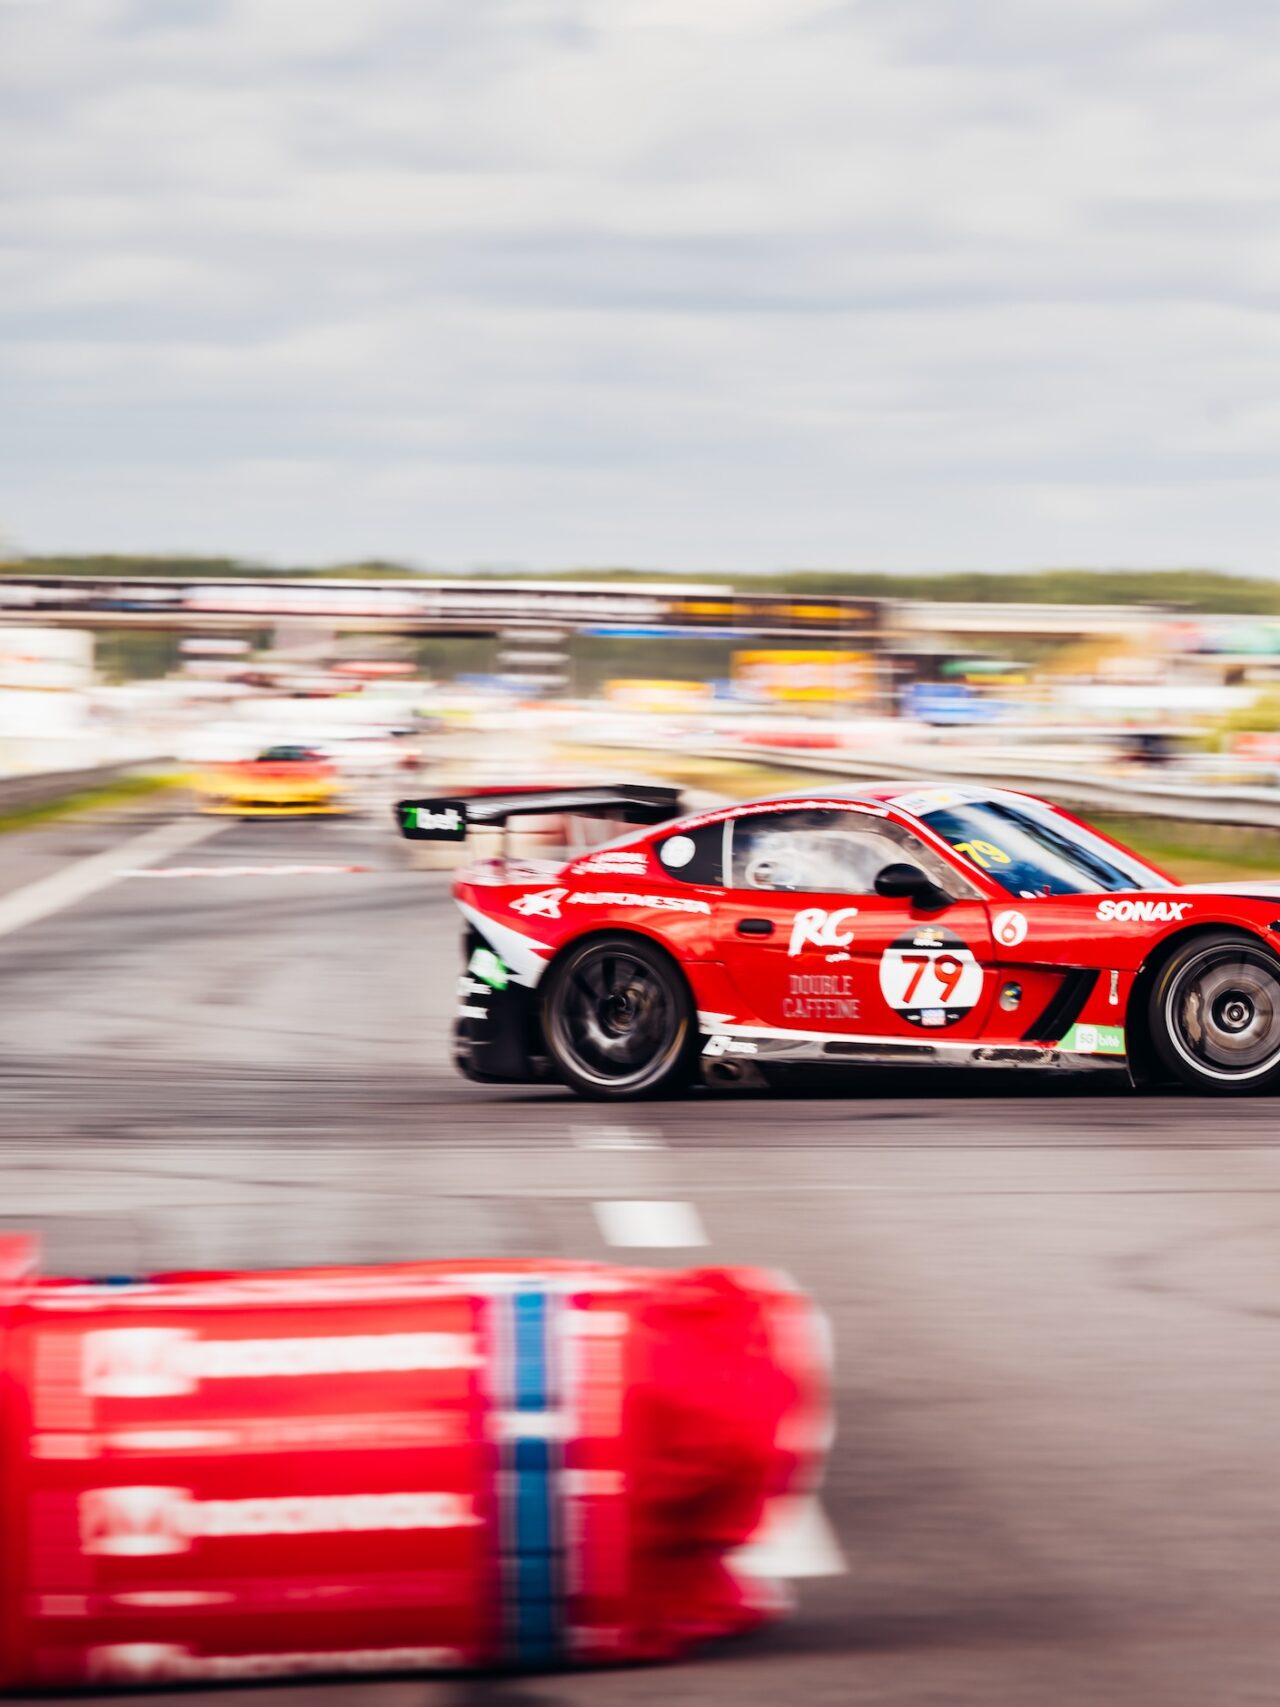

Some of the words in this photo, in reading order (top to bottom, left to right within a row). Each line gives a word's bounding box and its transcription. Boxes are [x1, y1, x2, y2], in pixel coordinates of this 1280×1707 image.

[952, 839, 1011, 868] 79
[1096, 900, 1186, 921] SONAX
[787, 907, 858, 957] RC
[1001, 913, 1018, 943] 6
[789, 974, 854, 995] DOUBLE
[901, 955, 963, 1004] 79
[783, 998, 861, 1018] CAFFEINE
